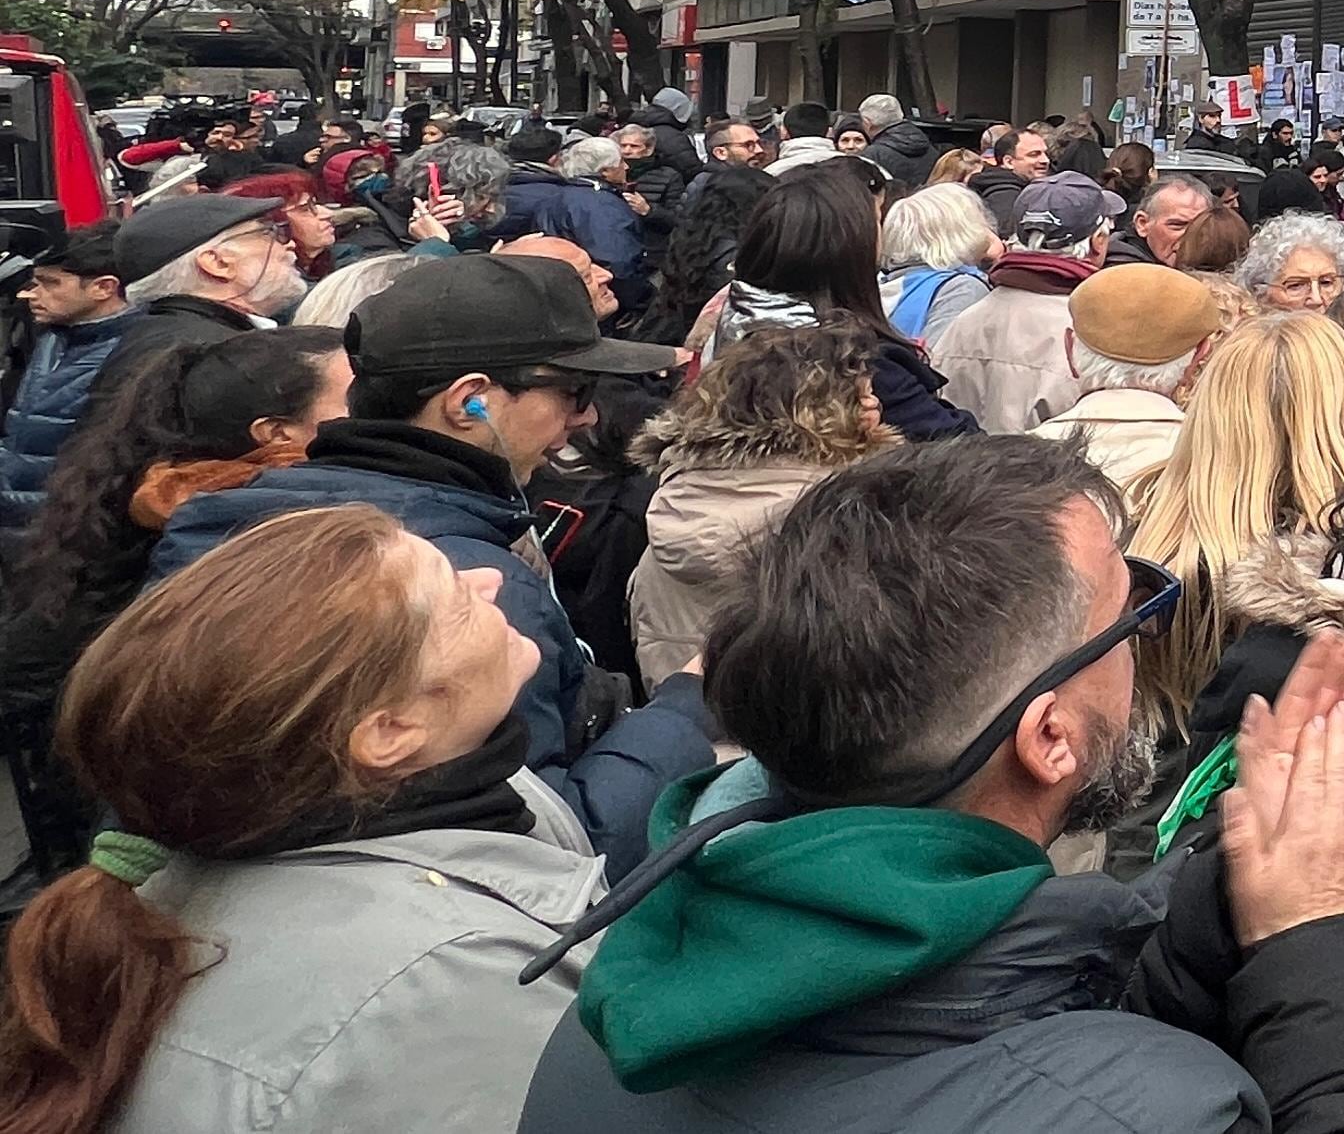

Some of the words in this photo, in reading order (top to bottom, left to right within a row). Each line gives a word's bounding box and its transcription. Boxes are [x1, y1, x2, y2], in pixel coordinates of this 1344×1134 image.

[1133, 12, 1145, 20] de
[1148, 12, 1154, 20] 7
[1228, 80, 1252, 120] L
